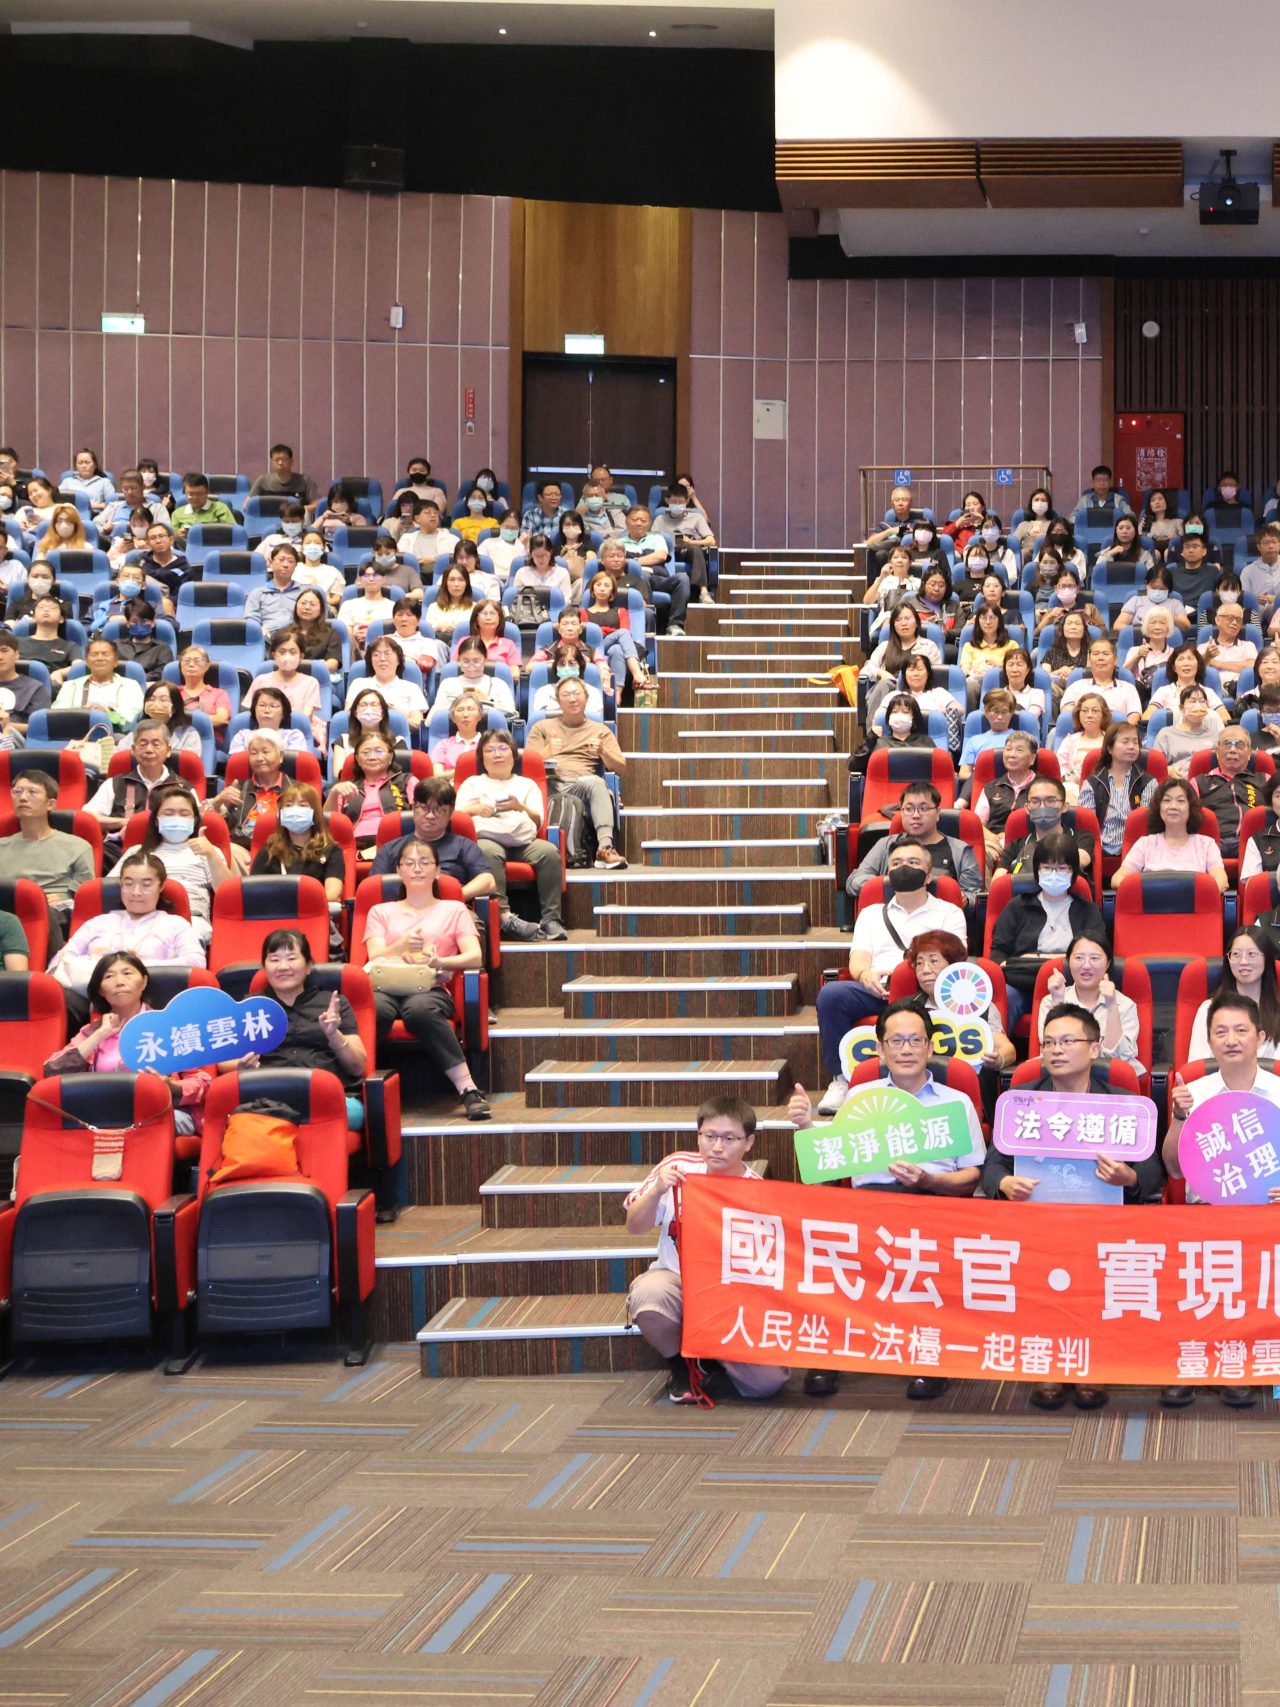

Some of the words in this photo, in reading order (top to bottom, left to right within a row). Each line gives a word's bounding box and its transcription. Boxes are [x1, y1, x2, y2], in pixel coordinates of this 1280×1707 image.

[136, 1009, 274, 1063] 永續雲林
[852, 1024, 983, 1063] SGs
[812, 1115, 954, 1171] 潔淨能源
[1014, 1109, 1138, 1146] 法令遵循
[1195, 1107, 1265, 1162] 誠信
[720, 1305, 1090, 1377] 人民坐上法檯一起審判
